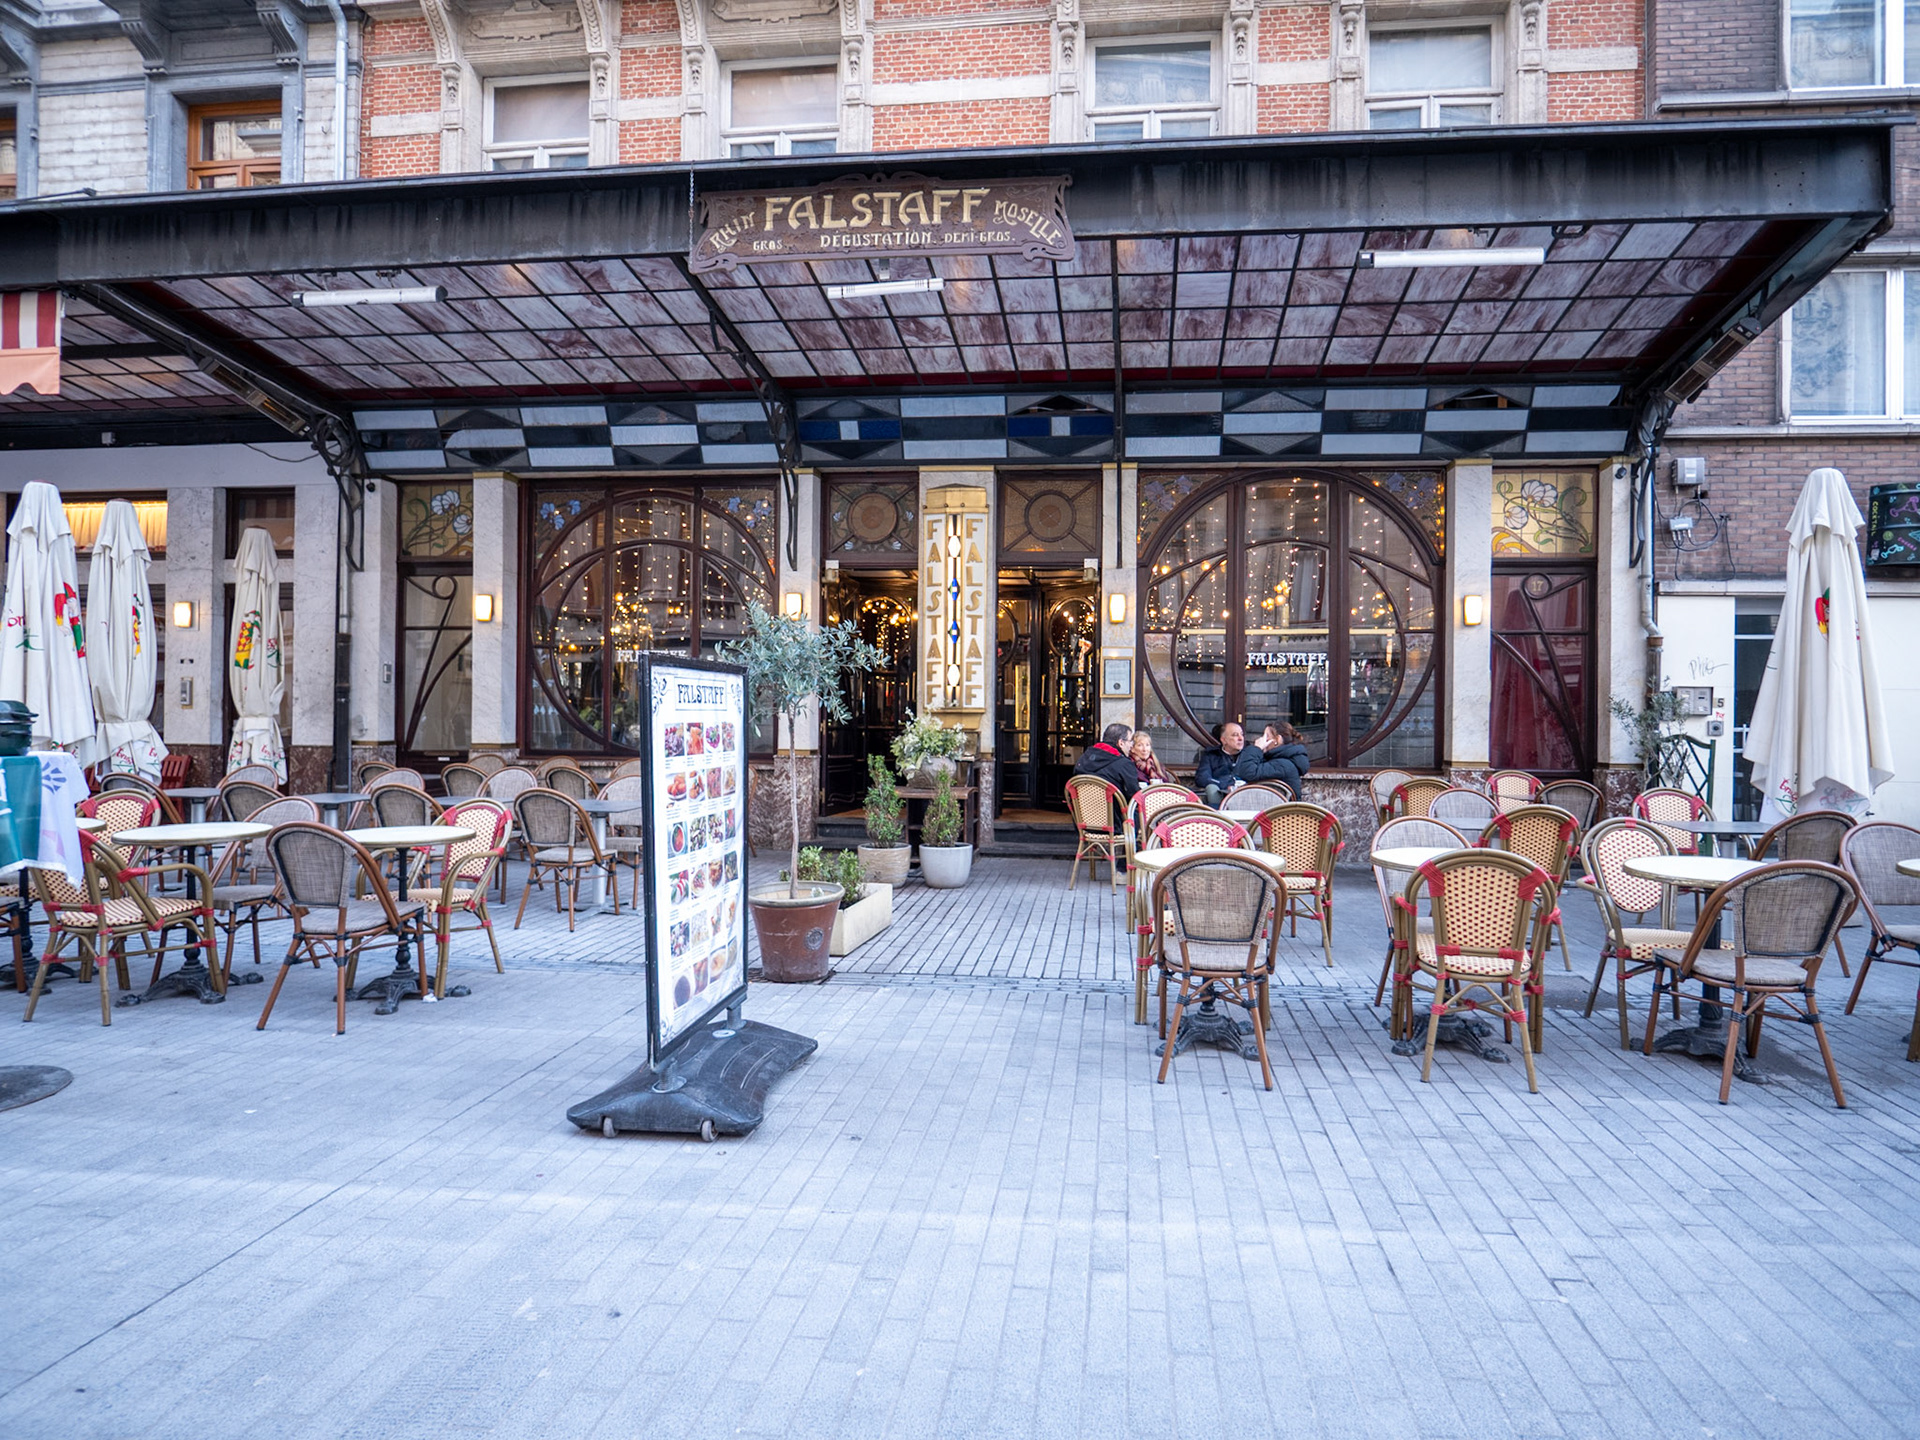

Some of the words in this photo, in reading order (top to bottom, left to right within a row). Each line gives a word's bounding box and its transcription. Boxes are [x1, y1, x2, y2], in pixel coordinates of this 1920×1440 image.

[709, 212, 755, 252] RHIN
[764, 187, 991, 231] FALSTAFF
[993, 200, 1062, 245] MOSELLE
[753, 240, 784, 251] GROS
[1531, 580, 1544, 592] 17
[926, 518, 943, 706] FALSTAFF
[965, 518, 983, 706] FALSTAFF
[1247, 652, 1328, 666] FALSTAFF
[677, 684, 725, 704] FALSTAFF
